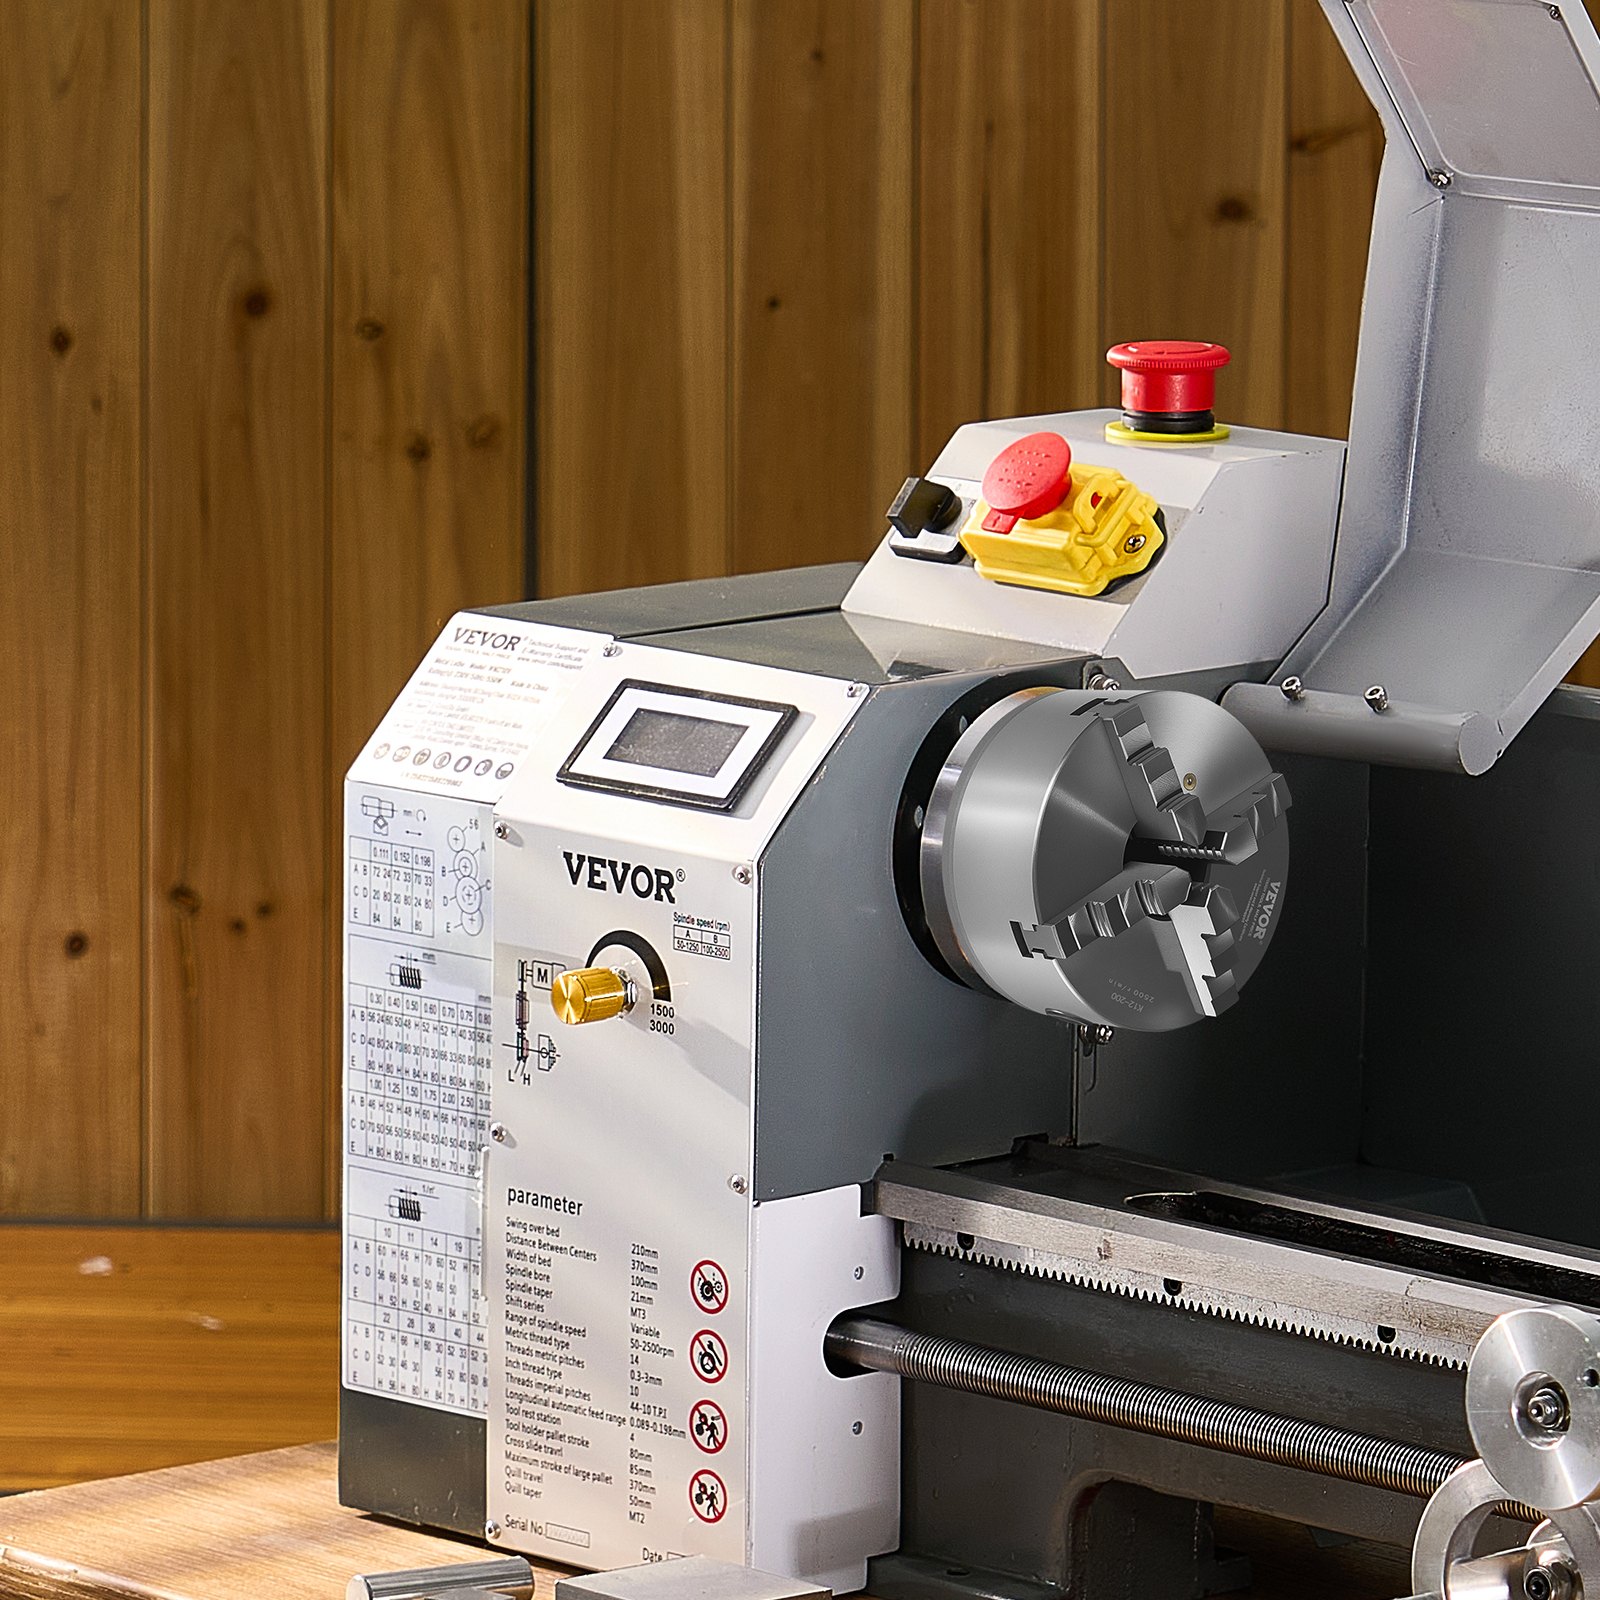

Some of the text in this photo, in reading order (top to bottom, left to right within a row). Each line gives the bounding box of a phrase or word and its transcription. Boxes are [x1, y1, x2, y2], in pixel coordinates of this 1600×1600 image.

[1253, 881, 1281, 940] VEVOR
[673, 911, 730, 932] Spindle speed (rpm)
[685, 929, 690, 938] A
[713, 934, 718, 943] B
[676, 939, 699, 952] 50-1250
[702, 945, 728, 957] 100-2500
[538, 968, 548, 984] M
[651, 1003, 675, 1019] 1500
[1111, 993, 1144, 1013] K12-200
[650, 1020, 675, 1035] 3000
[508, 1071, 514, 1082] L
[523, 1074, 530, 1085] H
[507, 1188, 582, 1216] parameter
[506, 1216, 560, 1237] Swing over bed
[506, 1231, 596, 1261] Distance Between Centers
[631, 1243, 658, 1259] 210mm
[506, 1248, 551, 1267] Width of bed
[505, 1263, 550, 1282] Spindle bore
[631, 1259, 658, 1274] 370mm
[505, 1278, 553, 1299] Spindle taper
[631, 1275, 657, 1290] 100mm
[505, 1294, 544, 1312] Shift series
[630, 1290, 653, 1304] 21mm
[630, 1306, 646, 1319] MT3
[505, 1309, 586, 1338] Range of spindle speed
[630, 1322, 660, 1338] Variable
[505, 1325, 569, 1350] Metric thread type
[505, 1340, 584, 1368] Threads metric pitches
[630, 1337, 674, 1358] 50-2500rpm
[630, 1353, 639, 1365] 14
[505, 1356, 562, 1380] Inch thread type
[630, 1369, 662, 1386] 0.3-3mm
[505, 1372, 590, 1401] Threads imperial pitches
[630, 1384, 639, 1396] 10
[505, 1387, 626, 1427] Longitudinal automatic feed range
[505, 1402, 561, 1425] Tool rest station
[630, 1401, 651, 1415] 44-10
[505, 1418, 589, 1448] Tool holder pallet stroke
[629, 1416, 686, 1439] 0.089-0.198mm
[504, 1434, 524, 1448] Cross
[525, 1439, 542, 1452] slide
[629, 1432, 634, 1441] 4
[629, 1447, 651, 1462] 80mm
[504, 1449, 612, 1484] Maximum stroke of large pallet
[504, 1465, 543, 1483] Quill travel
[629, 1463, 651, 1478] 85mm
[504, 1480, 542, 1498] Quill taper
[629, 1478, 655, 1494] 370mm
[629, 1494, 651, 1509] 50mm
[505, 1514, 528, 1531] Serial
[629, 1510, 644, 1524] MT2
[642, 1547, 662, 1563] Date
